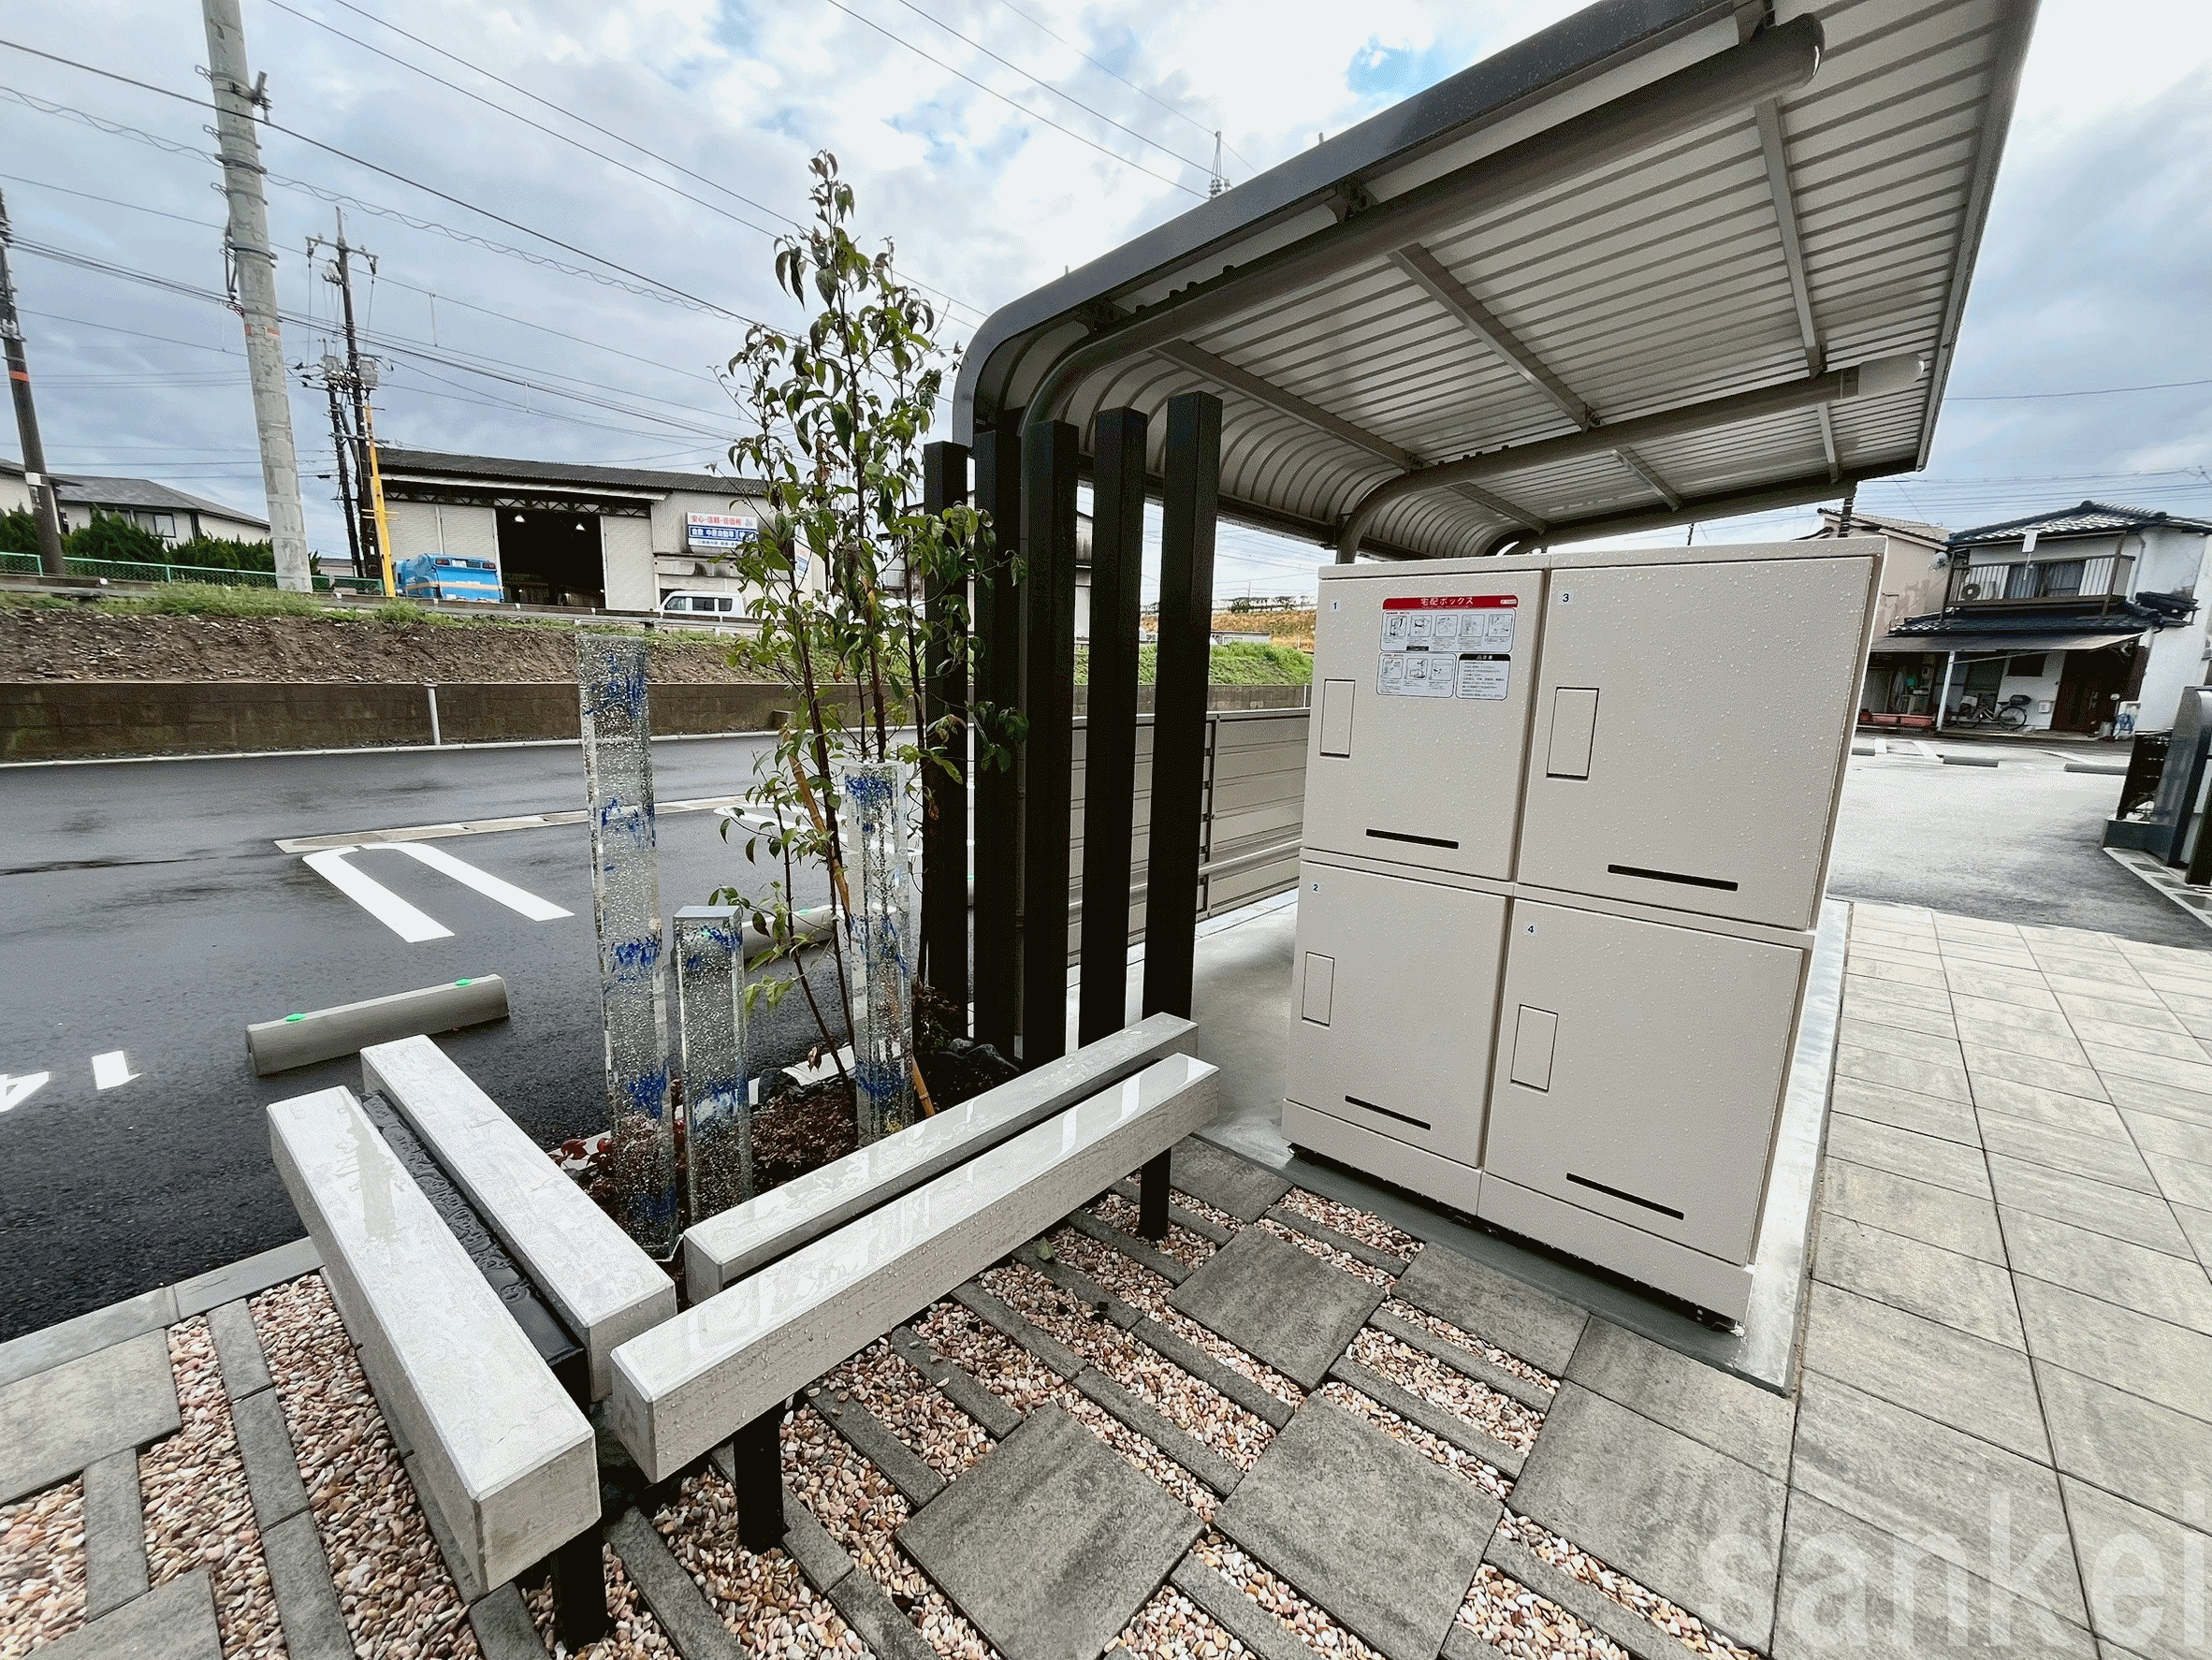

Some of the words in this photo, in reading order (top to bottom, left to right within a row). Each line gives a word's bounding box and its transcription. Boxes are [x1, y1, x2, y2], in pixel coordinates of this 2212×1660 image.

[1420, 597, 1474, 606] 宅配ボックス
[1563, 593, 1569, 602] 3
[1313, 883, 1318, 892] 2
[1527, 925, 1535, 933] 4
